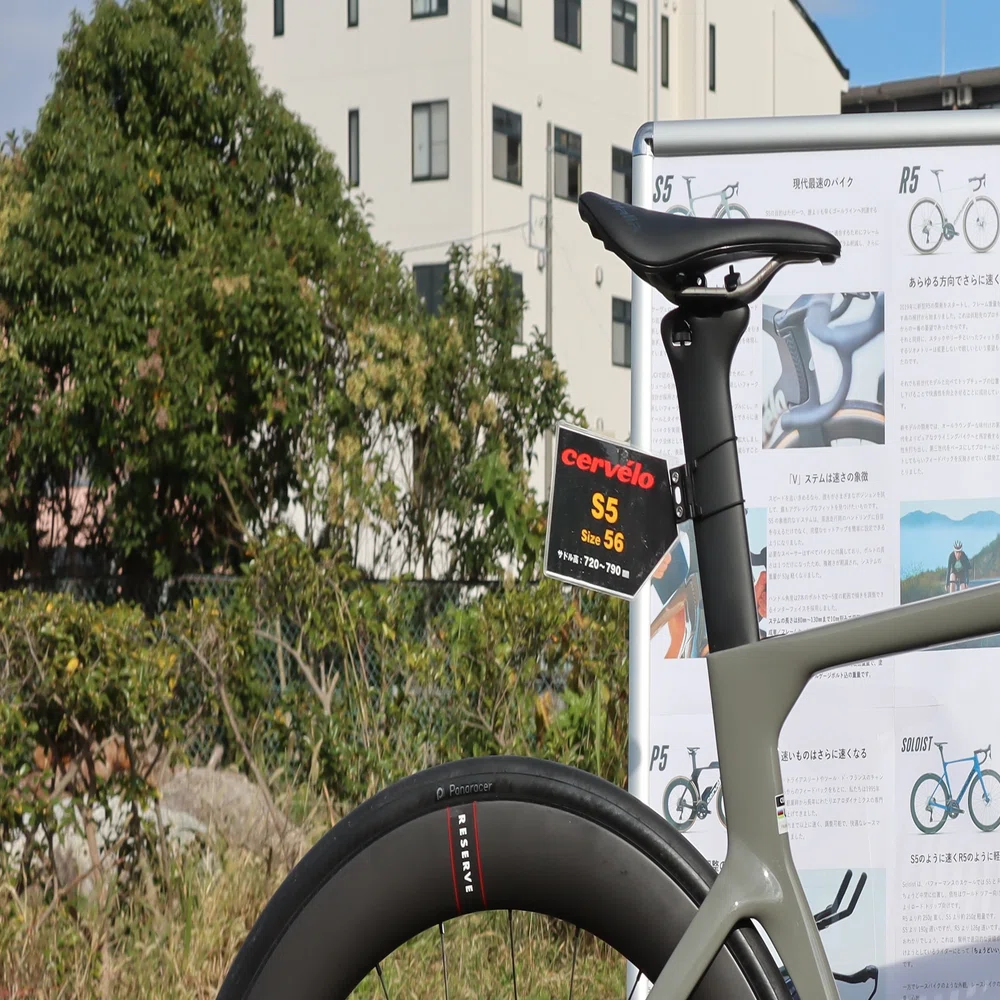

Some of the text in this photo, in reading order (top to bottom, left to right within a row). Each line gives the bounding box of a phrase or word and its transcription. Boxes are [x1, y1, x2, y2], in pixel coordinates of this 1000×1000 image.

[652, 174, 674, 203] S5
[792, 176, 854, 190] 現代最速のバイク
[898, 165, 921, 195] R5
[909, 274, 1000, 288] あらゆる方向でさらに速く
[561, 448, 655, 489] cervélo
[591, 492, 619, 524] S5
[580, 528, 625, 553] Size 56
[781, 748, 867, 762] 速いものはさらに速くなる
[901, 736, 933, 752] SOLOIST
[649, 744, 670, 771] P5
[449, 782, 493, 797] Panaracer
[458, 813, 474, 893] RESERVE
